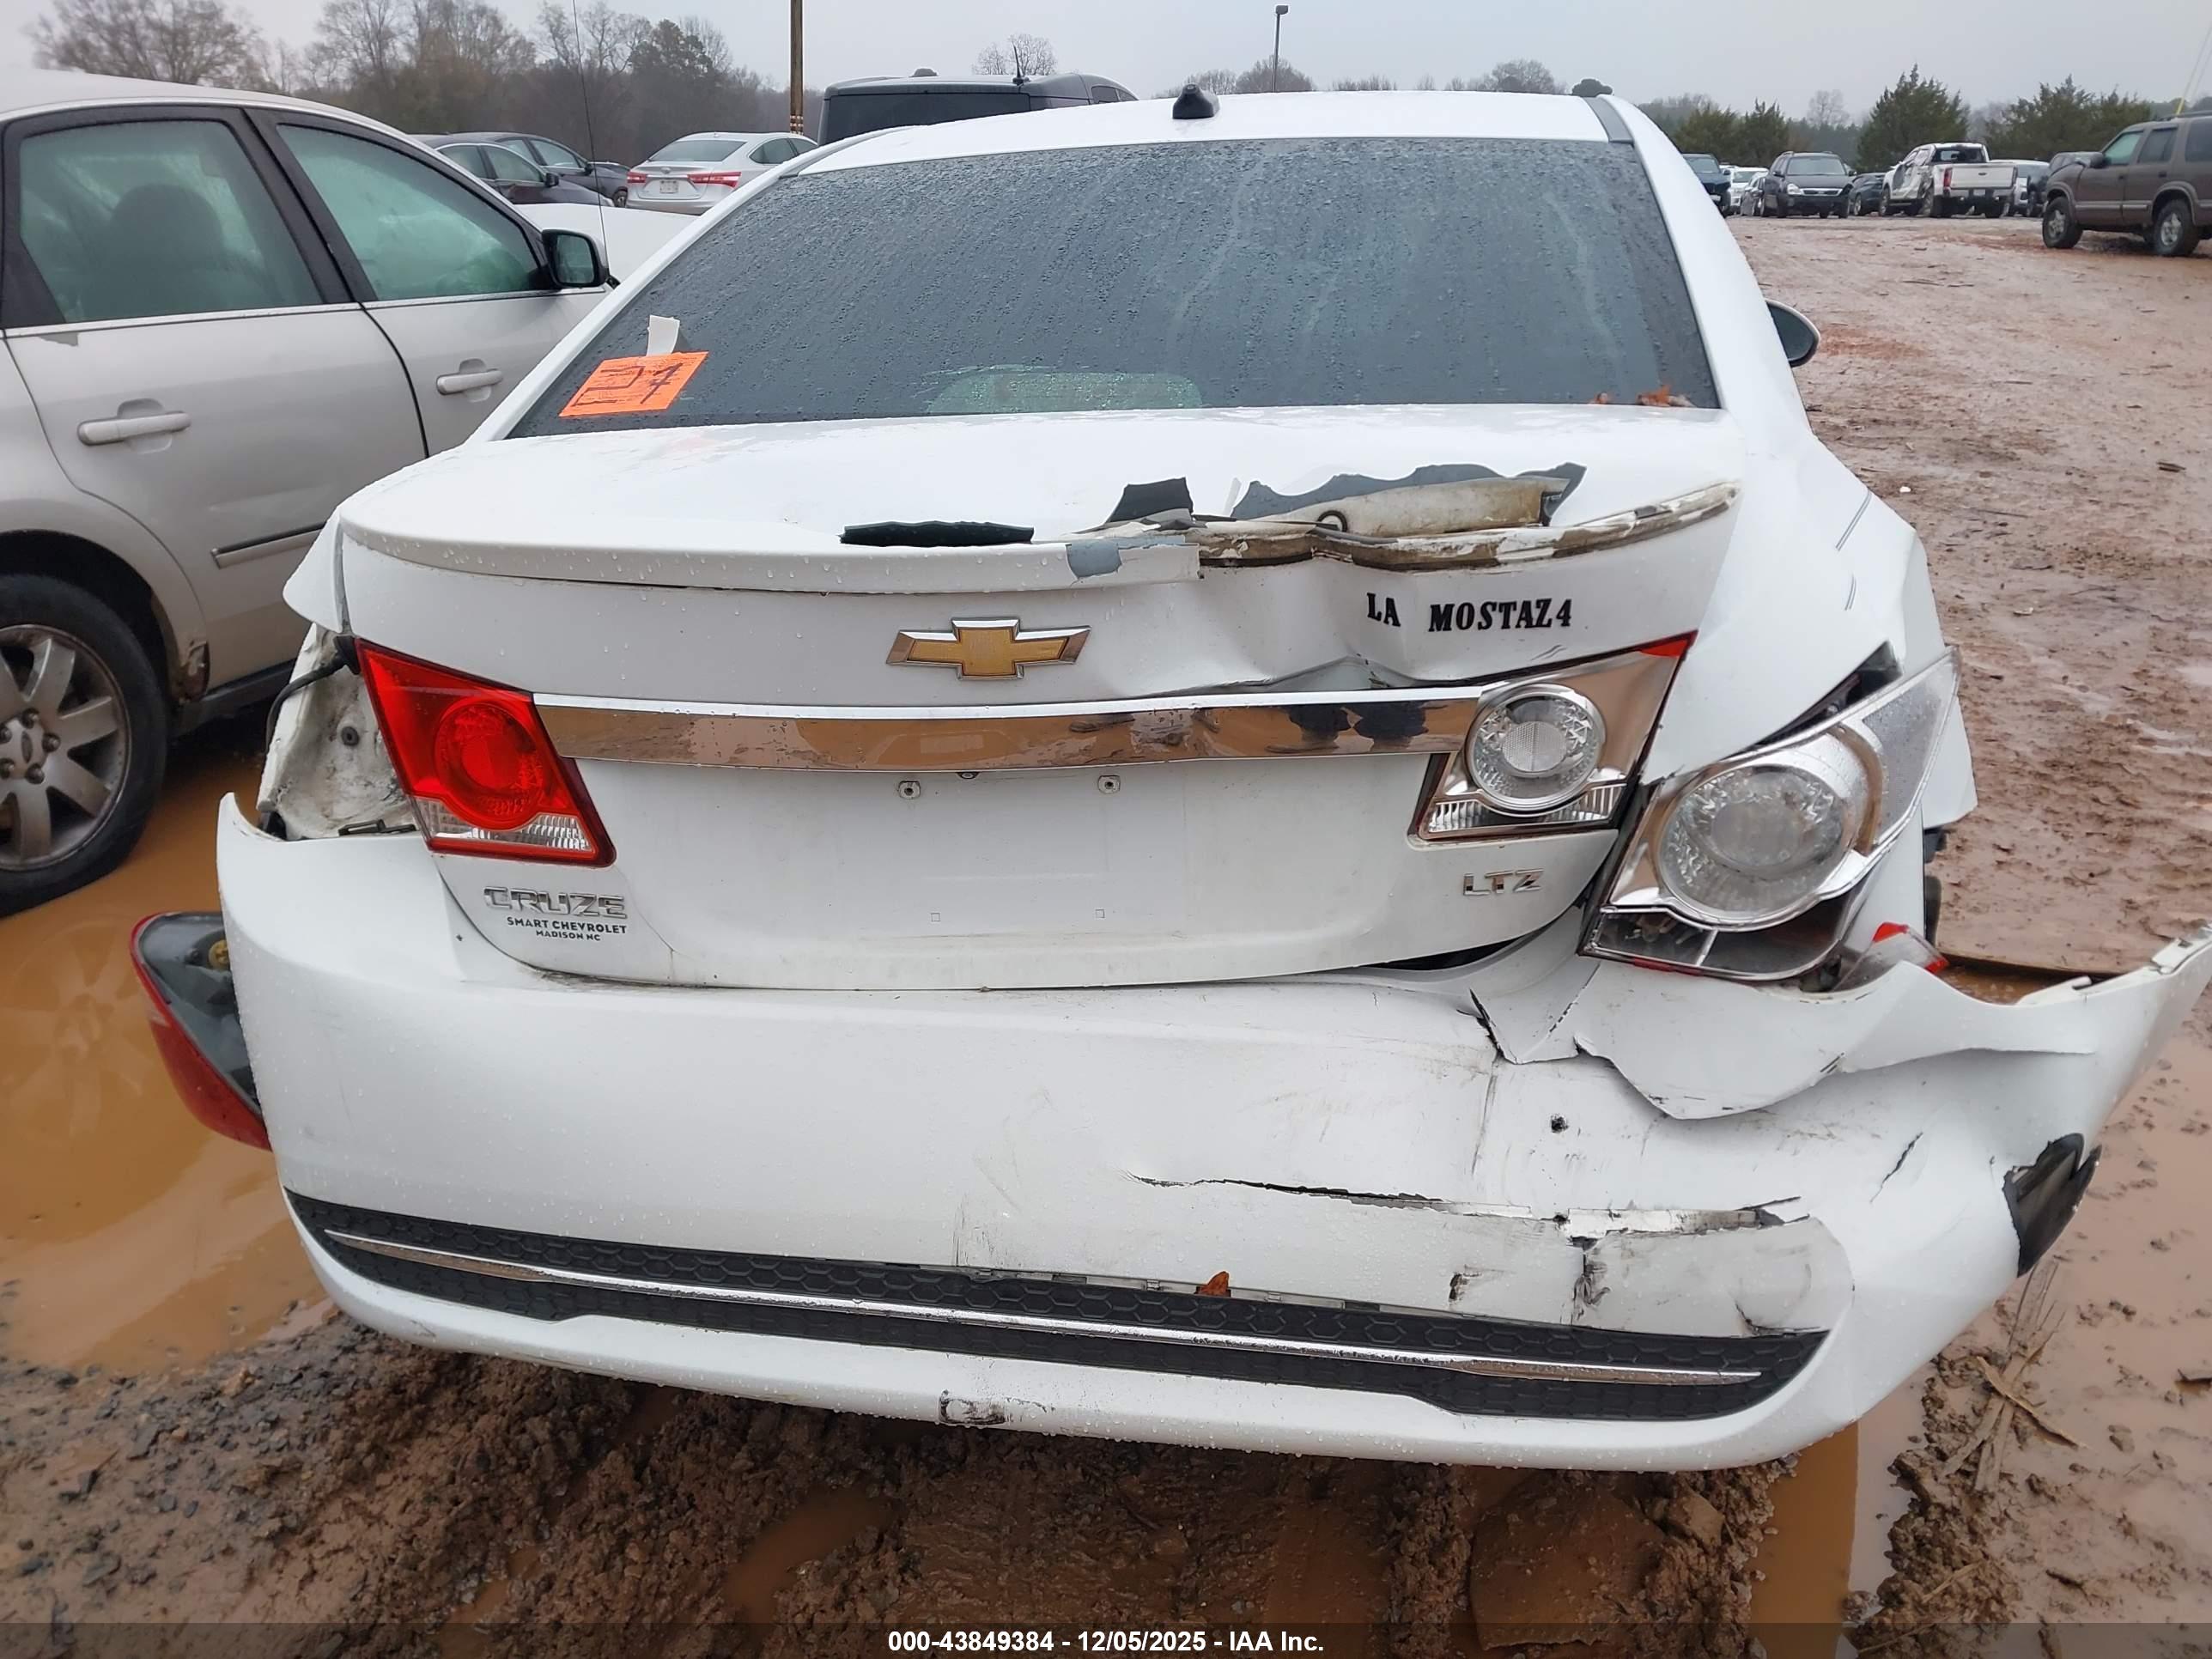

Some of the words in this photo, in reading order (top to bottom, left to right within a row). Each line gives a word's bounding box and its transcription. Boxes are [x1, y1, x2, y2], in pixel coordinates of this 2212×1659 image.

[1366, 592, 1401, 627] LA
[1428, 599, 1572, 632] MOSTAZ4
[1463, 868, 1545, 896] LTZ
[483, 886, 629, 919] CRUZE
[507, 916, 549, 928] SMART
[551, 921, 627, 933] CHEVROLET
[536, 930, 584, 939] MADISON
